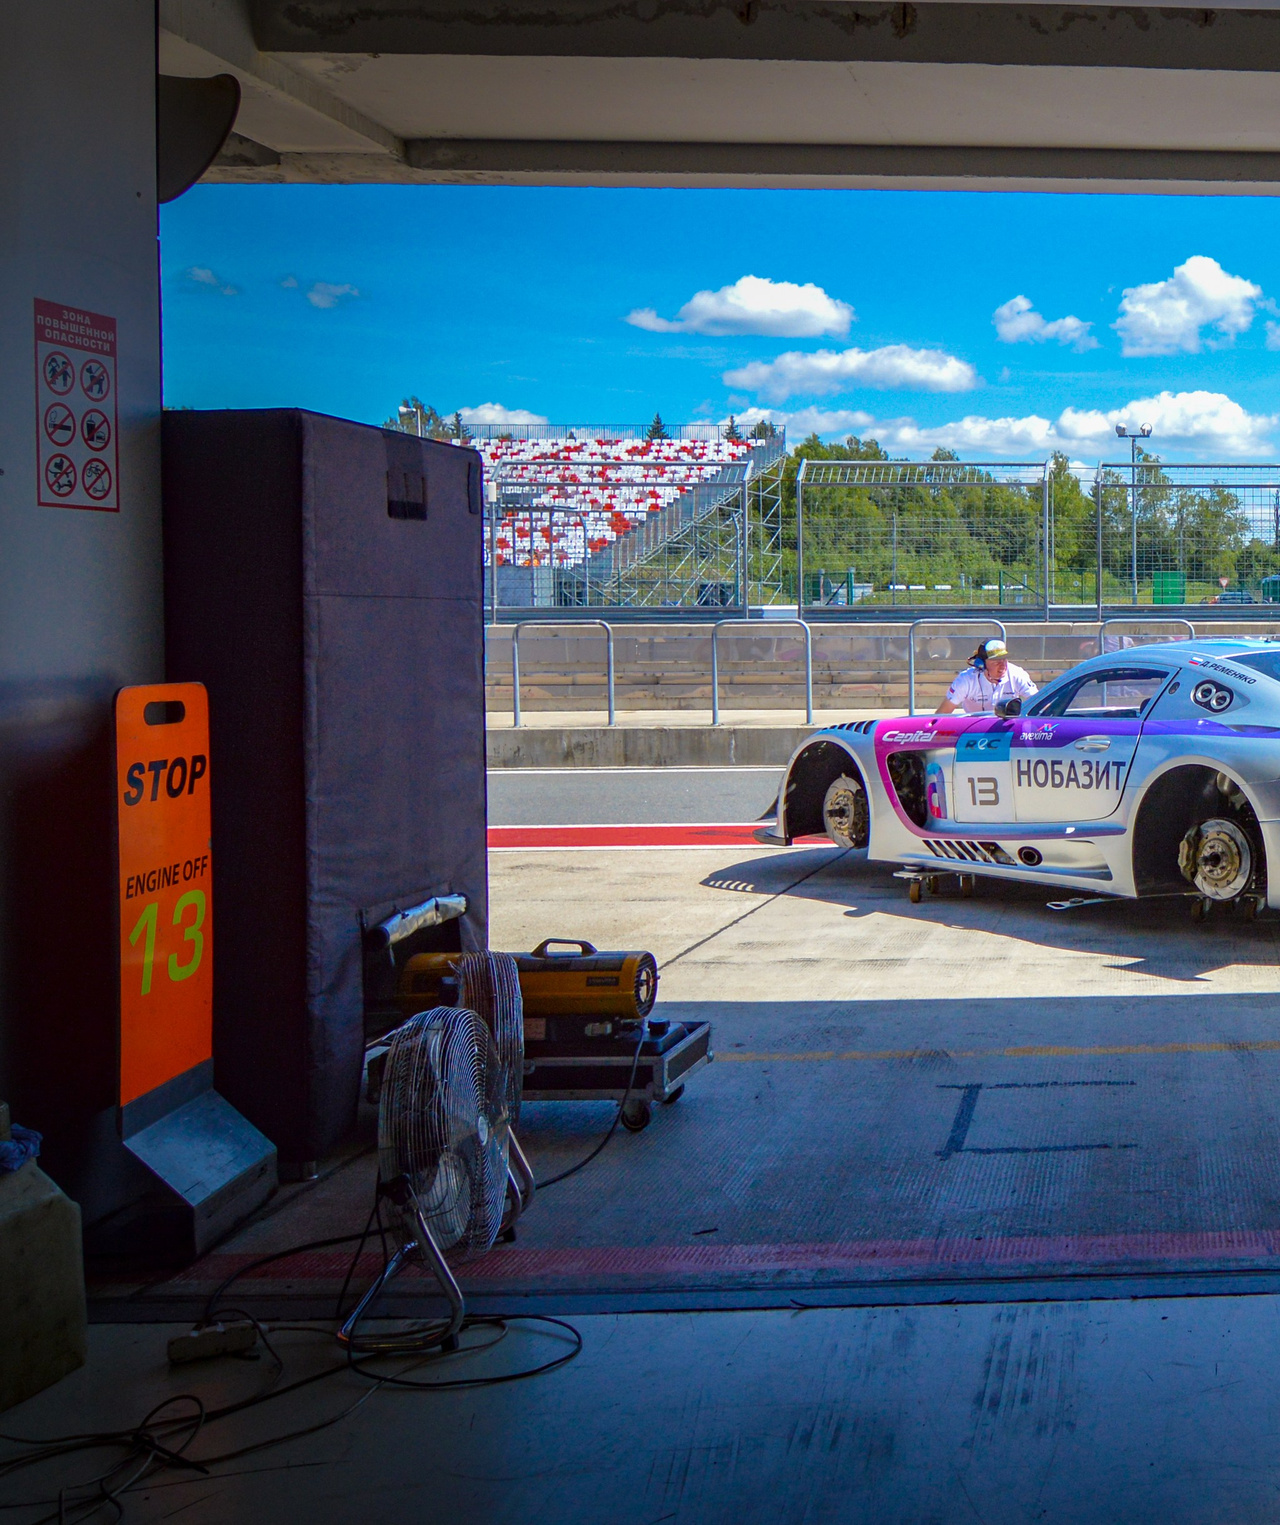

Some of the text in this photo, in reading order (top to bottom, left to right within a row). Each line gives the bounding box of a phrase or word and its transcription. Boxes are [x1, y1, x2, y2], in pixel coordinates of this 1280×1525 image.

[37, 315, 115, 342] ПОВЫШЕННОЙ
[62, 310, 91, 325] ЗОНА
[45, 329, 111, 352] ОПАСНОСТИ
[1019, 730, 1053, 741] avexima
[123, 753, 207, 807] STOP
[1017, 759, 1126, 790] НОБАЗИТ
[967, 777, 999, 806] 13
[126, 855, 208, 900] ENGINE OFF
[128, 889, 206, 997] 13
